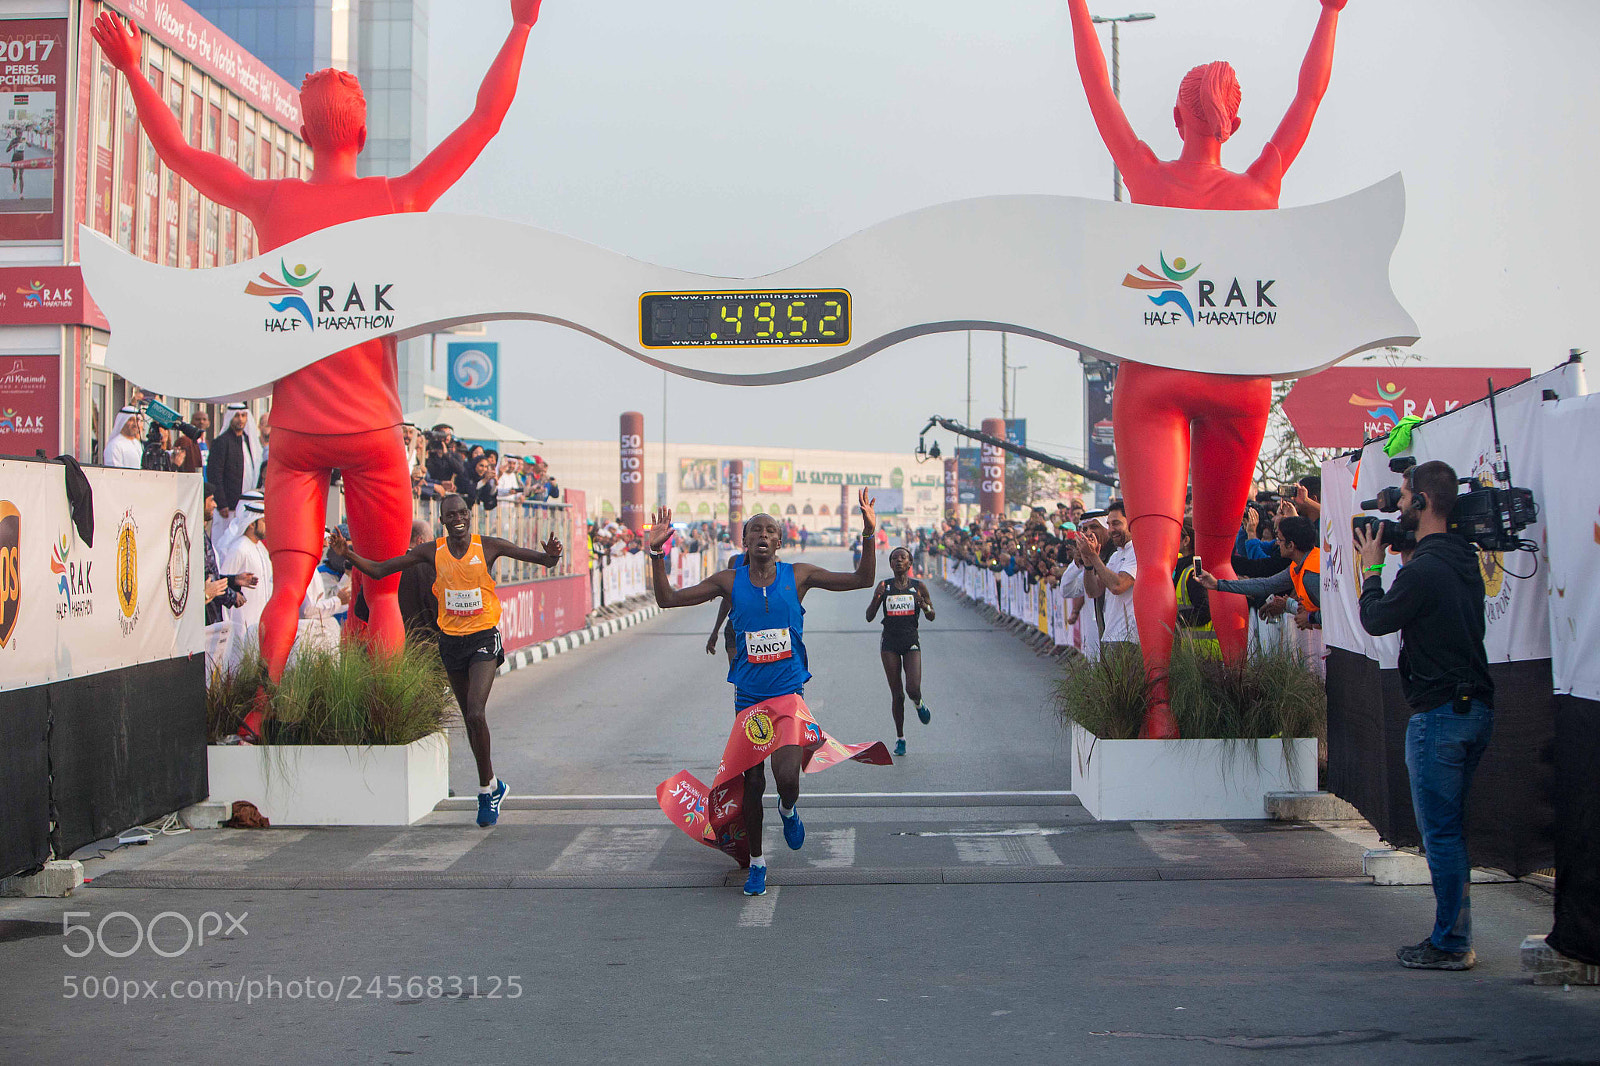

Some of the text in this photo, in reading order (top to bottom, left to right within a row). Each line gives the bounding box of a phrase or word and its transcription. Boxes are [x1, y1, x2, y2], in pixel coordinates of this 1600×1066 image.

[187, 22, 198, 50] to
[199, 29, 211, 61] the
[0, 40, 55, 62] 2017
[5, 64, 40, 75] PERES
[43, 288, 72, 300] RAK
[318, 282, 395, 312] RAK
[671, 293, 818, 301] www.premiertiming.com
[1198, 277, 1278, 307] RAK
[264, 315, 395, 333] HALF MARATHON
[1144, 311, 1277, 326] HALF MARATHON
[671, 338, 819, 346] www.premiertiming.com
[1403, 398, 1460, 421] RAK
[15, 416, 44, 428] RAK
[621, 435, 641, 449] 50
[982, 442, 1003, 457] 50
[622, 457, 640, 469] TO
[621, 471, 642, 484] GO
[795, 470, 882, 486] AL SAFEER MARKET
[945, 471, 957, 482] 21
[983, 465, 1002, 478] TO
[981, 480, 1003, 493] GO
[69, 558, 93, 596] RAK
[71, 599, 93, 618] MARATHON
[750, 640, 787, 654] FANCY
[756, 652, 781, 662] ELITE
[668, 784, 697, 811] RAK
